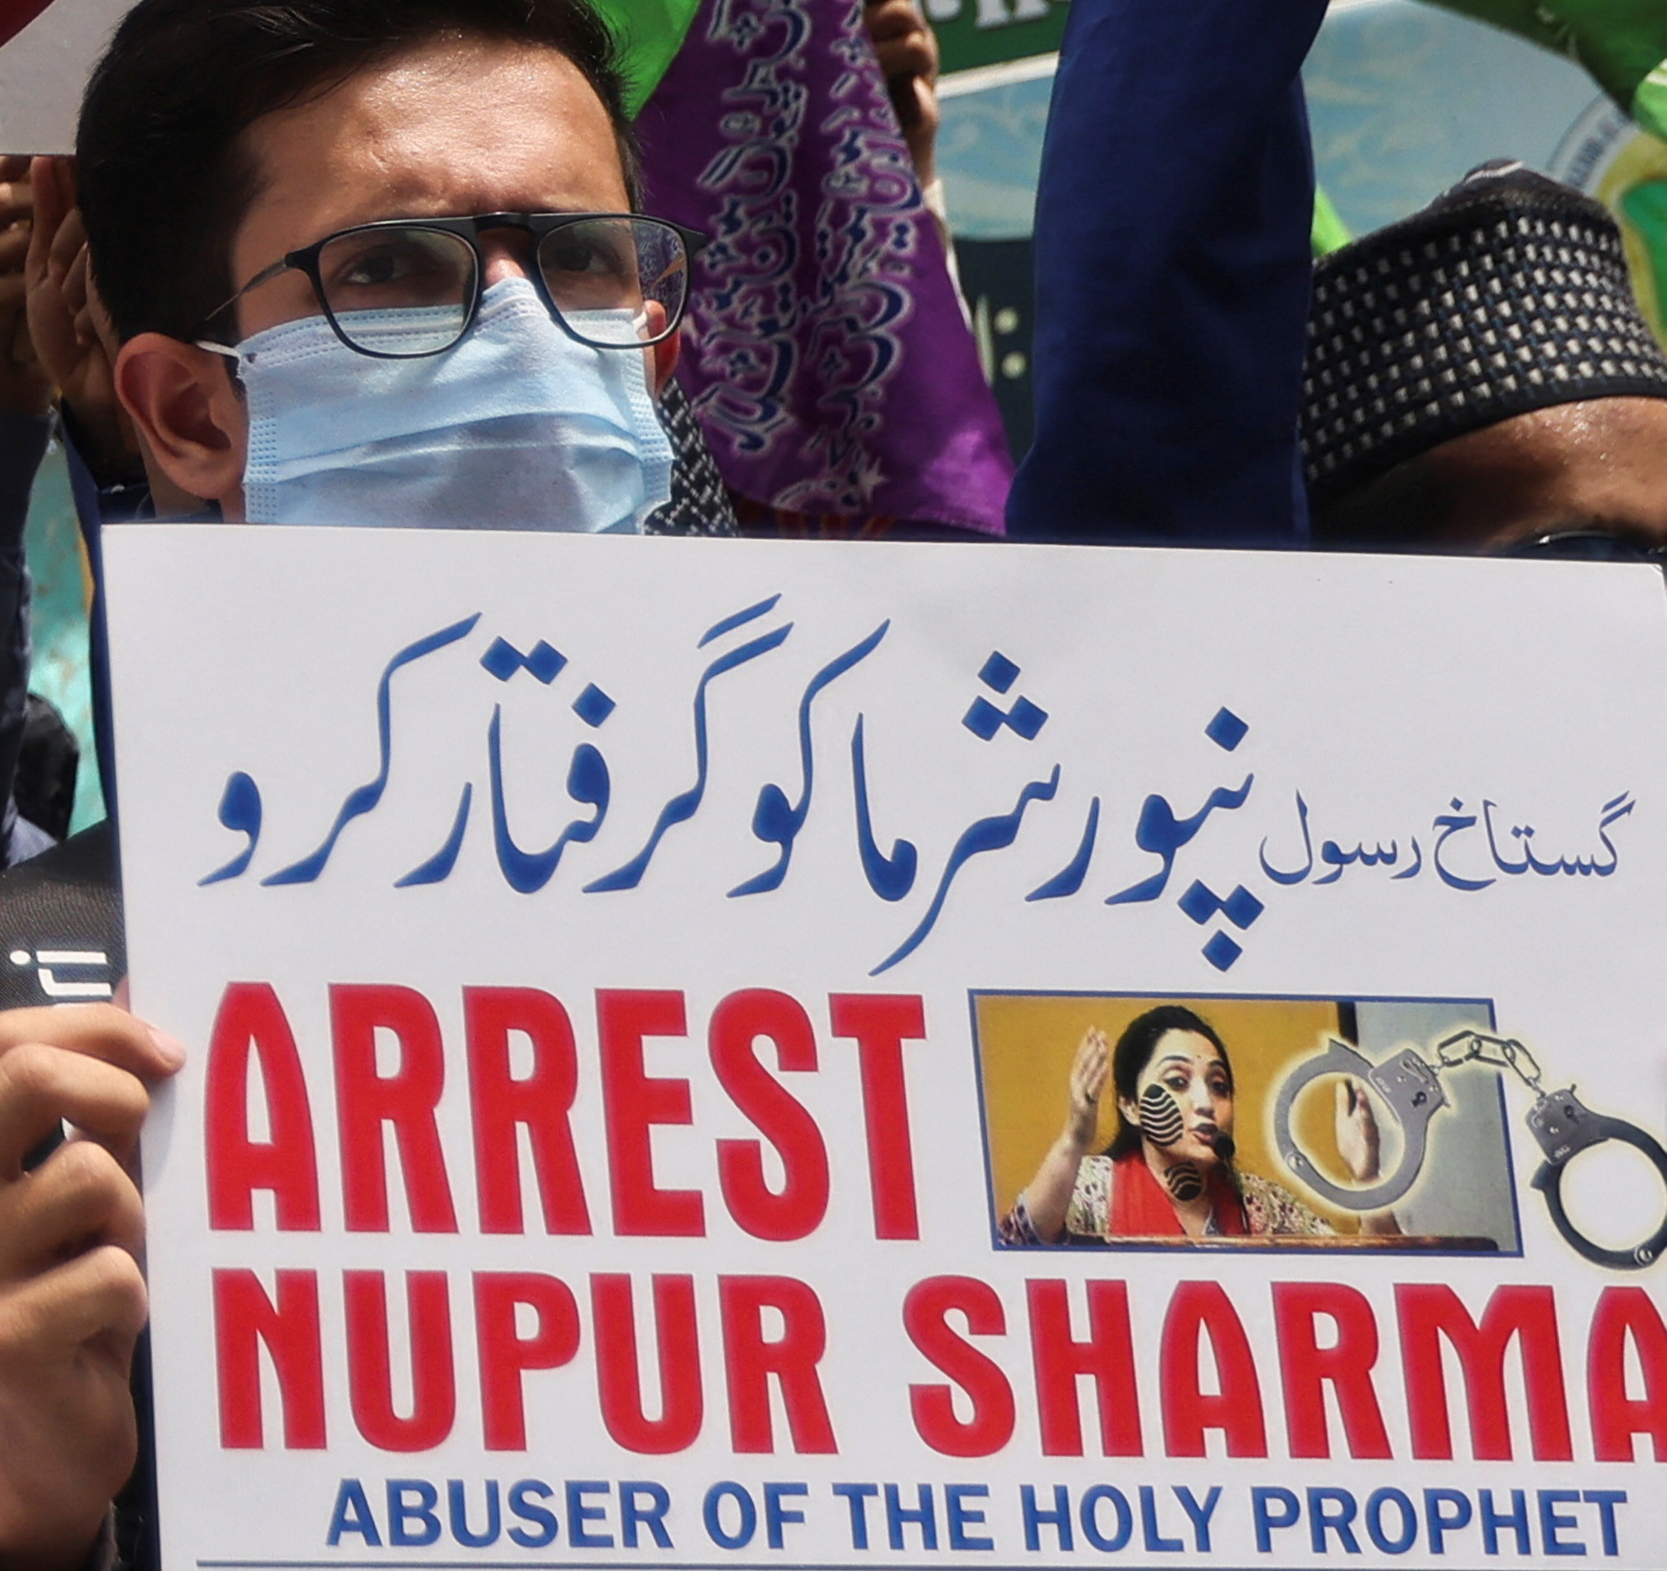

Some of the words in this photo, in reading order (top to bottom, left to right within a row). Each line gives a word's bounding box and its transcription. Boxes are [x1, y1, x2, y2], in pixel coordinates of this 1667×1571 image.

[197, 610, 483, 888] کرو
[393, 592, 795, 895] گرفتار
[726, 617, 891, 898] کو
[852, 649, 1062, 976] شرما
[1258, 788, 1423, 887] رسول
[1432, 789, 1637, 892] گستاخ
[203, 980, 928, 1243] ARREST
[211, 1266, 840, 1456] NUPUR
[901, 1273, 1667, 1463] SHARMA
[324, 1476, 673, 1550] ABUSER
[702, 1479, 809, 1551] OF
[831, 1481, 996, 1553] THE
[1019, 1483, 1224, 1554] HOLY
[1251, 1486, 1629, 1558] PROPHET
